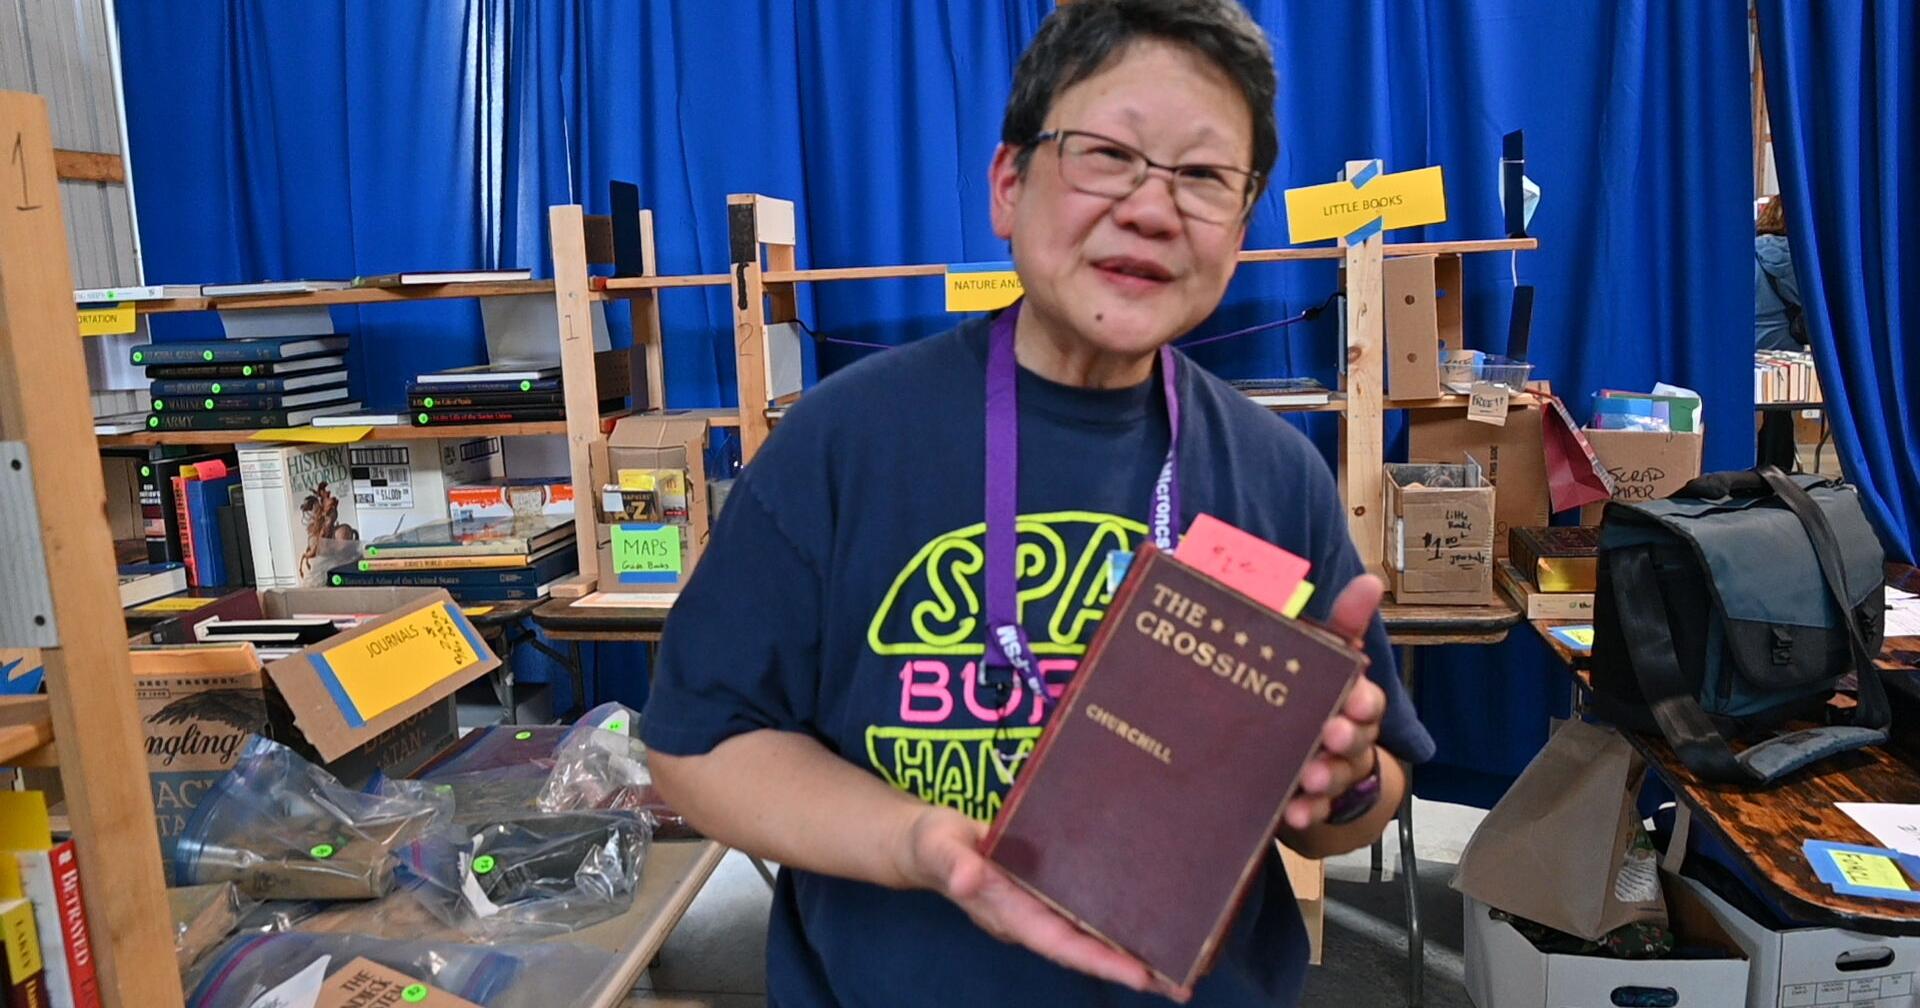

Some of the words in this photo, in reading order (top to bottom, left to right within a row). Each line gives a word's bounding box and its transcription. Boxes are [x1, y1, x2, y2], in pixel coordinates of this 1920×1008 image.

[1323, 201, 1360, 217] LITTLE
[1362, 194, 1404, 211] BOOKS
[953, 280, 998, 291] NATURE
[287, 447, 345, 477] HISTORY
[301, 463, 348, 488] WORLD
[623, 538, 668, 557] MAPS
[1153, 583, 1208, 628] THE
[365, 624, 421, 659] JOURNALS
[1135, 611, 1288, 707] CROSSING
[1085, 703, 1173, 765] CHURCHILL
[61, 868, 90, 967] BETRAYED
